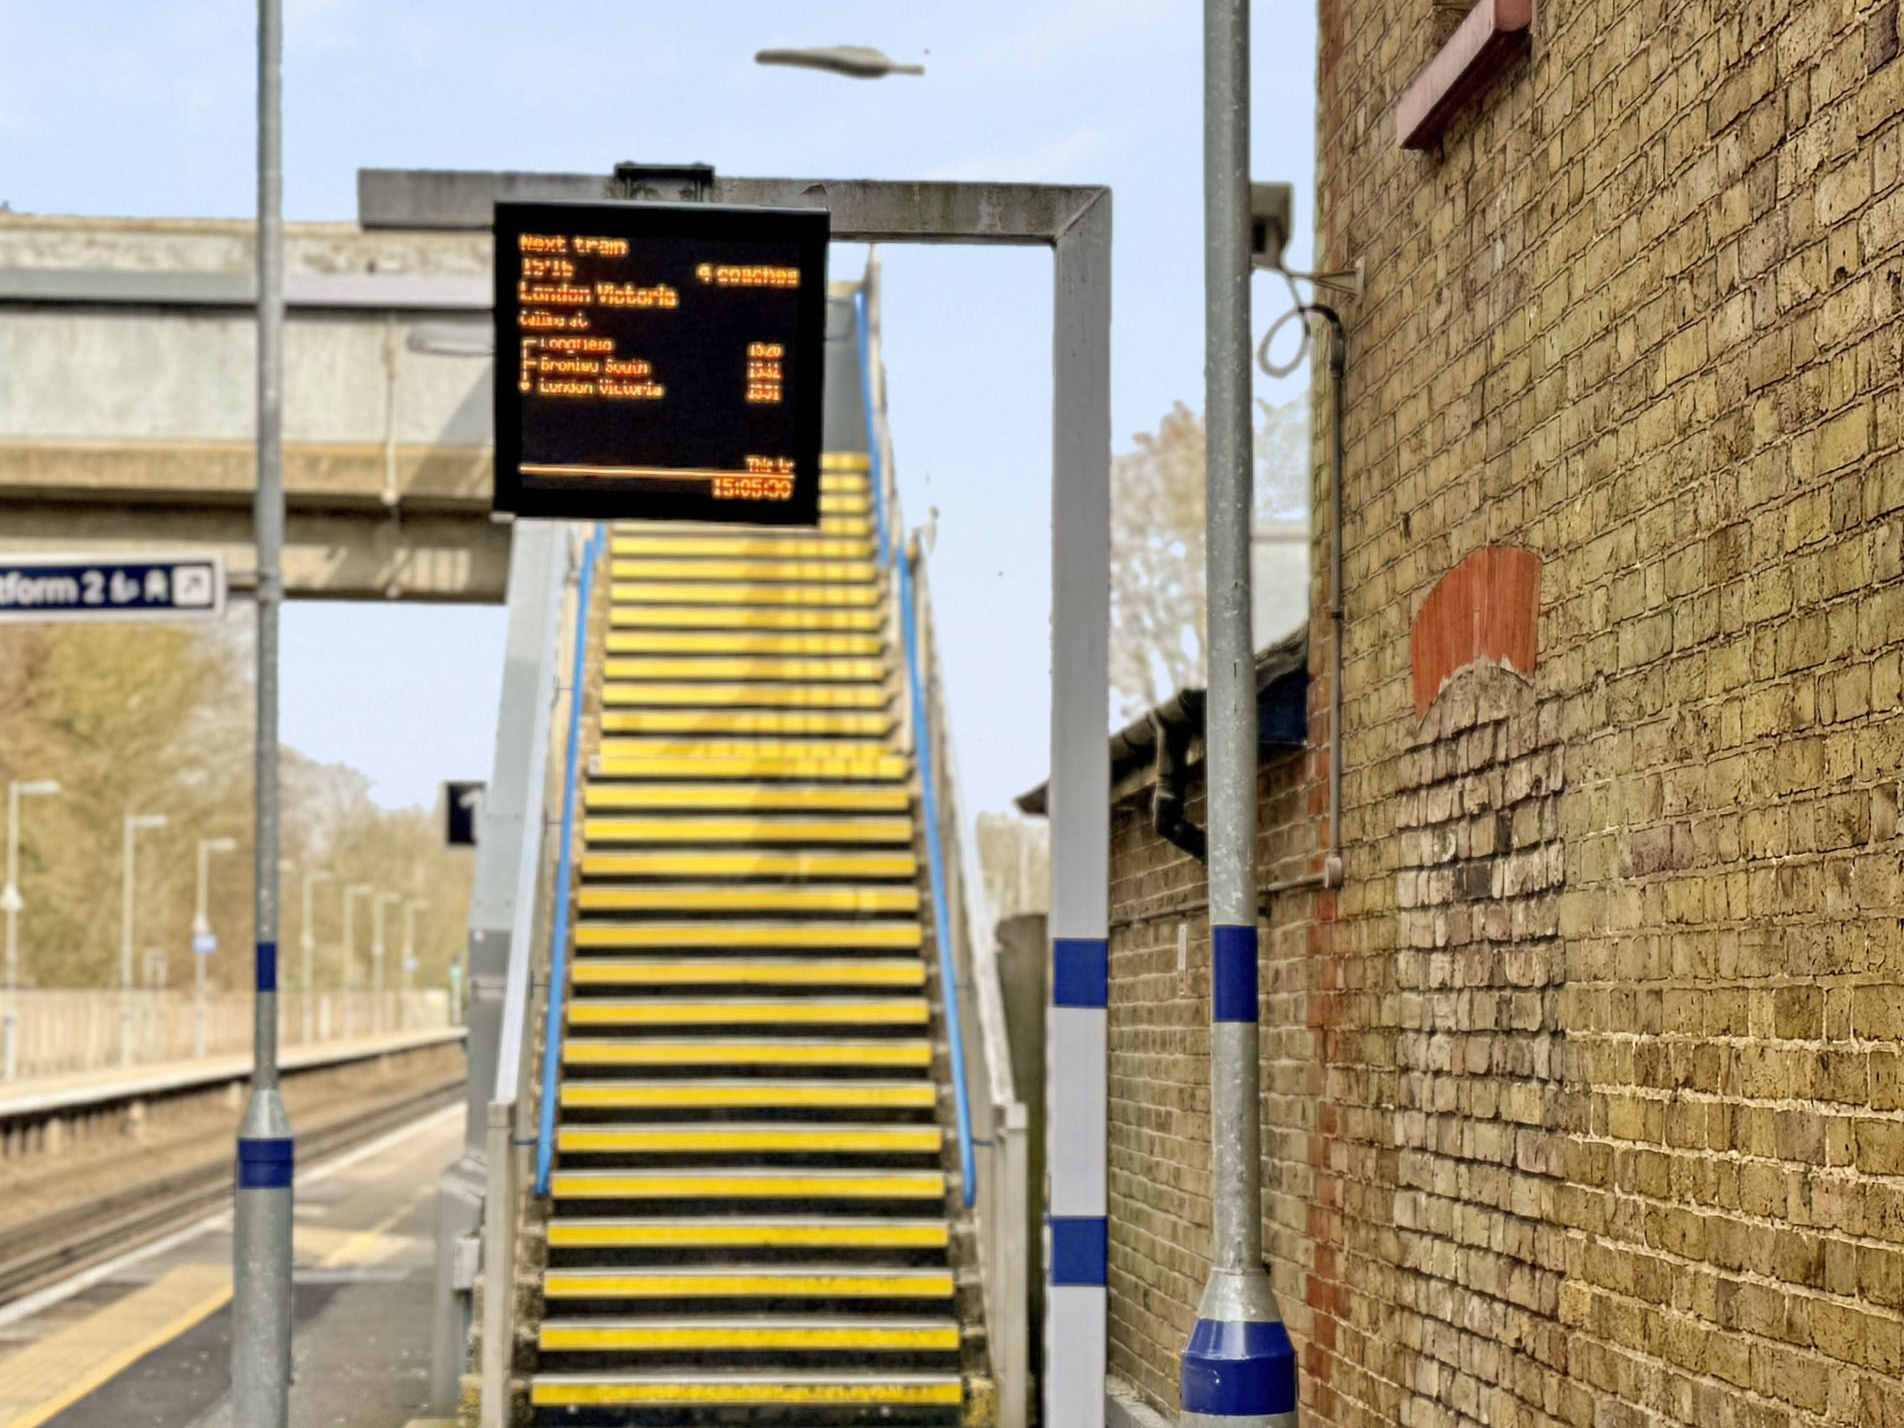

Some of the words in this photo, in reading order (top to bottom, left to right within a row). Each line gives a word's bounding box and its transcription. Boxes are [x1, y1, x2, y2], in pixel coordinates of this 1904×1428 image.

[519, 235, 566, 252] Next
[574, 236, 629, 256] train
[519, 281, 592, 303] London
[597, 282, 678, 308] Victoria
[539, 377, 594, 395] London
[599, 379, 665, 398] Victoria
[82, 572, 104, 603] 2
